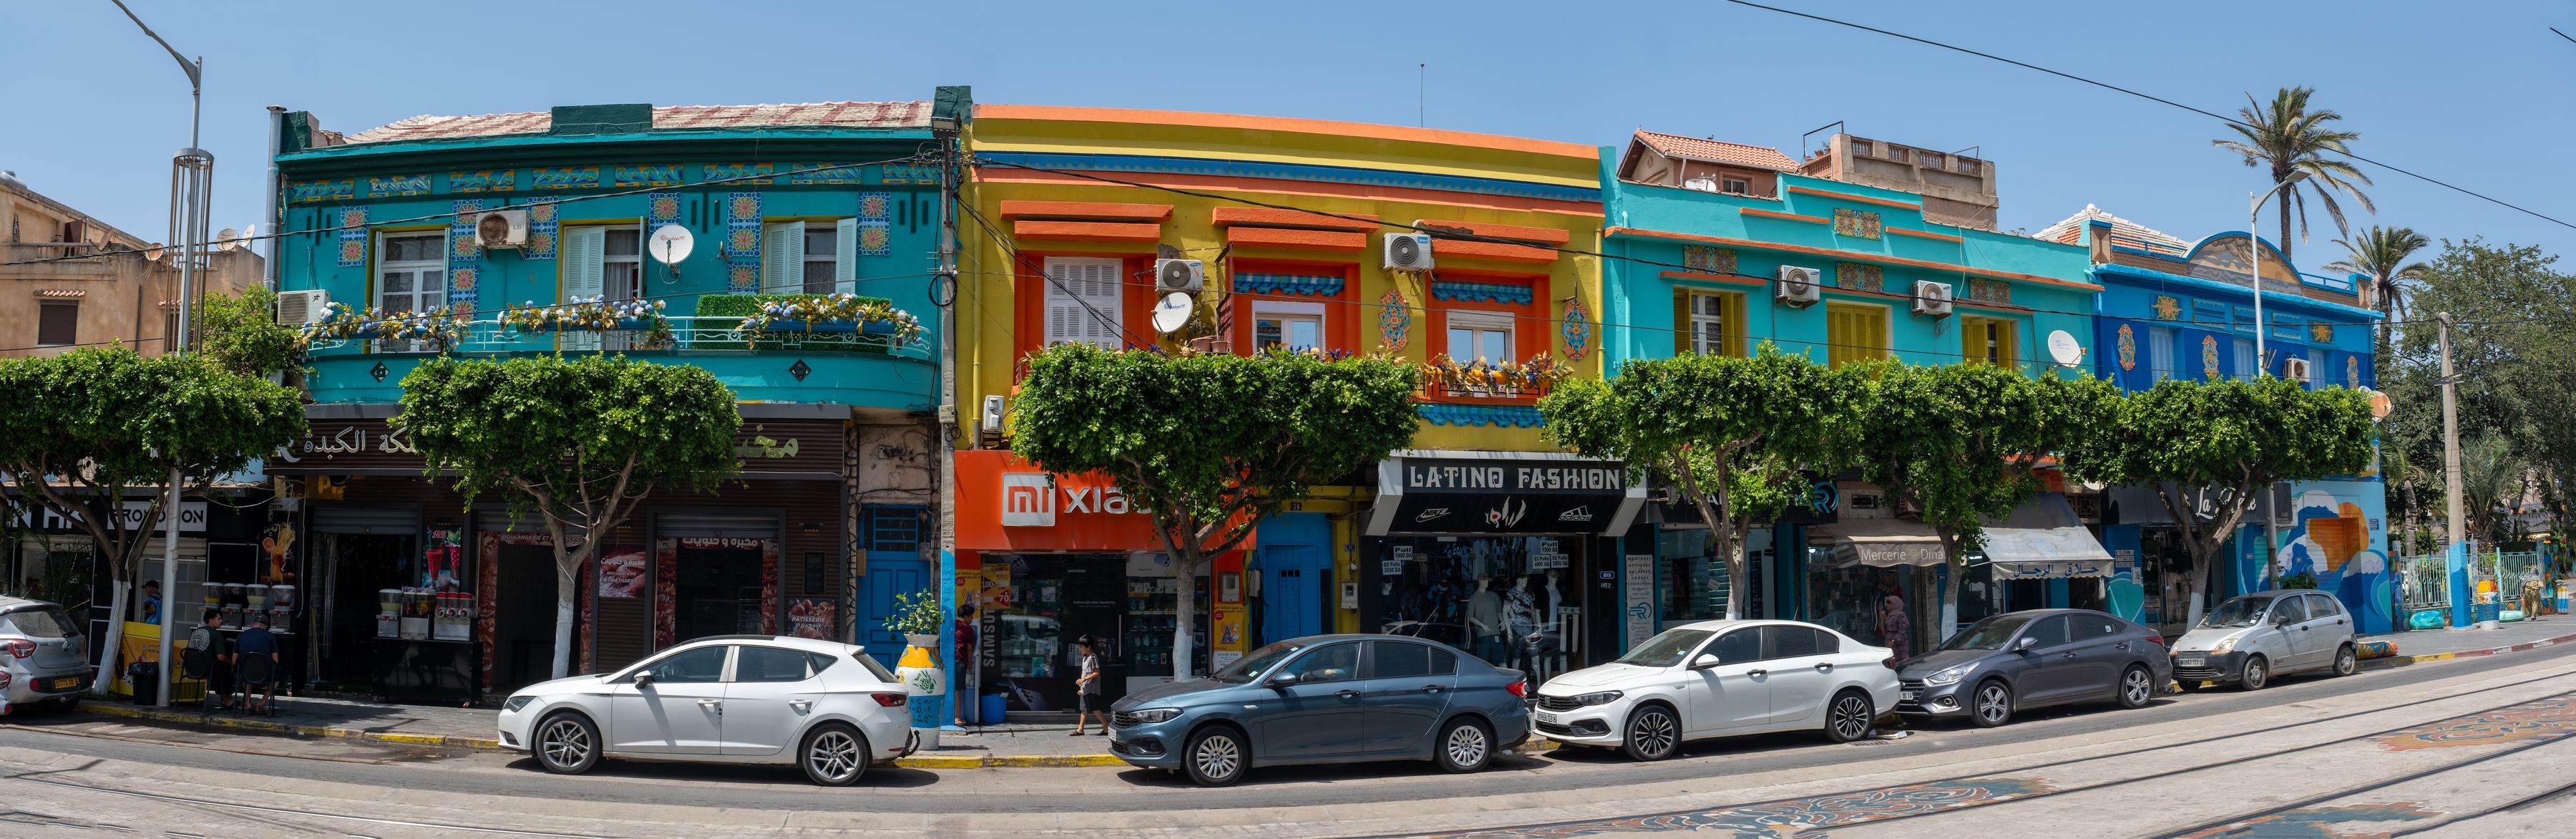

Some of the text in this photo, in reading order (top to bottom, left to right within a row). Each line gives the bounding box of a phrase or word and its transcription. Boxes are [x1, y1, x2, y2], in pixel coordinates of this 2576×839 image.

[1409, 465, 1621, 490] LATINO FASHION
[1421, 508, 1448, 518] NIKE
[1861, 549, 1906, 561] Mercerie
[2014, 563, 2099, 578] حلاق الرجال
